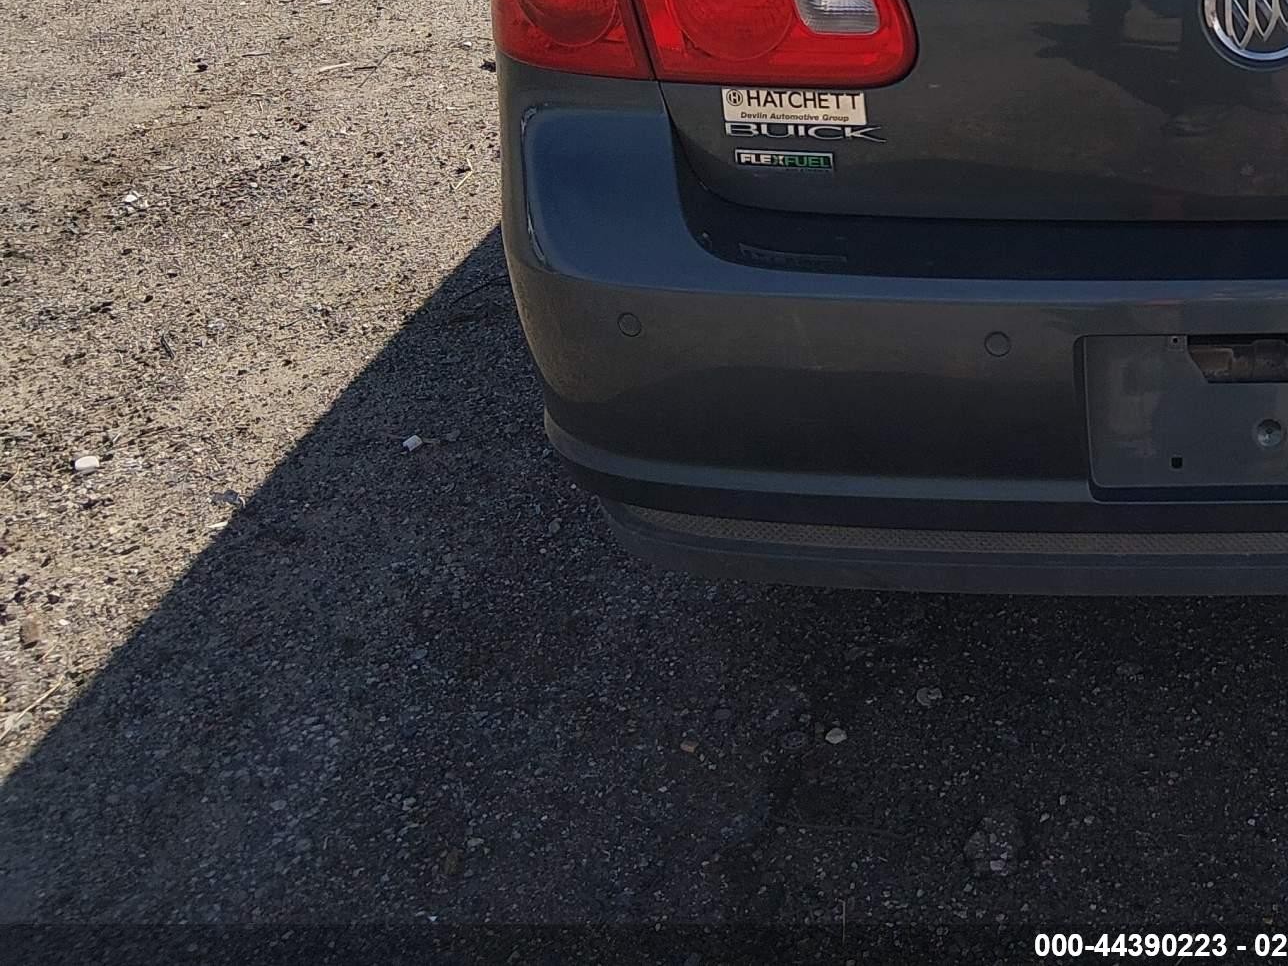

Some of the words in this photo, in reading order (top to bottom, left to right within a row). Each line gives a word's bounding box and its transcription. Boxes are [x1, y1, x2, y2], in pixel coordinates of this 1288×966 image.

[747, 90, 861, 110] HATCHETT
[770, 112, 819, 121] Automotive
[822, 113, 849, 122] Group
[725, 123, 887, 143] BUICK
